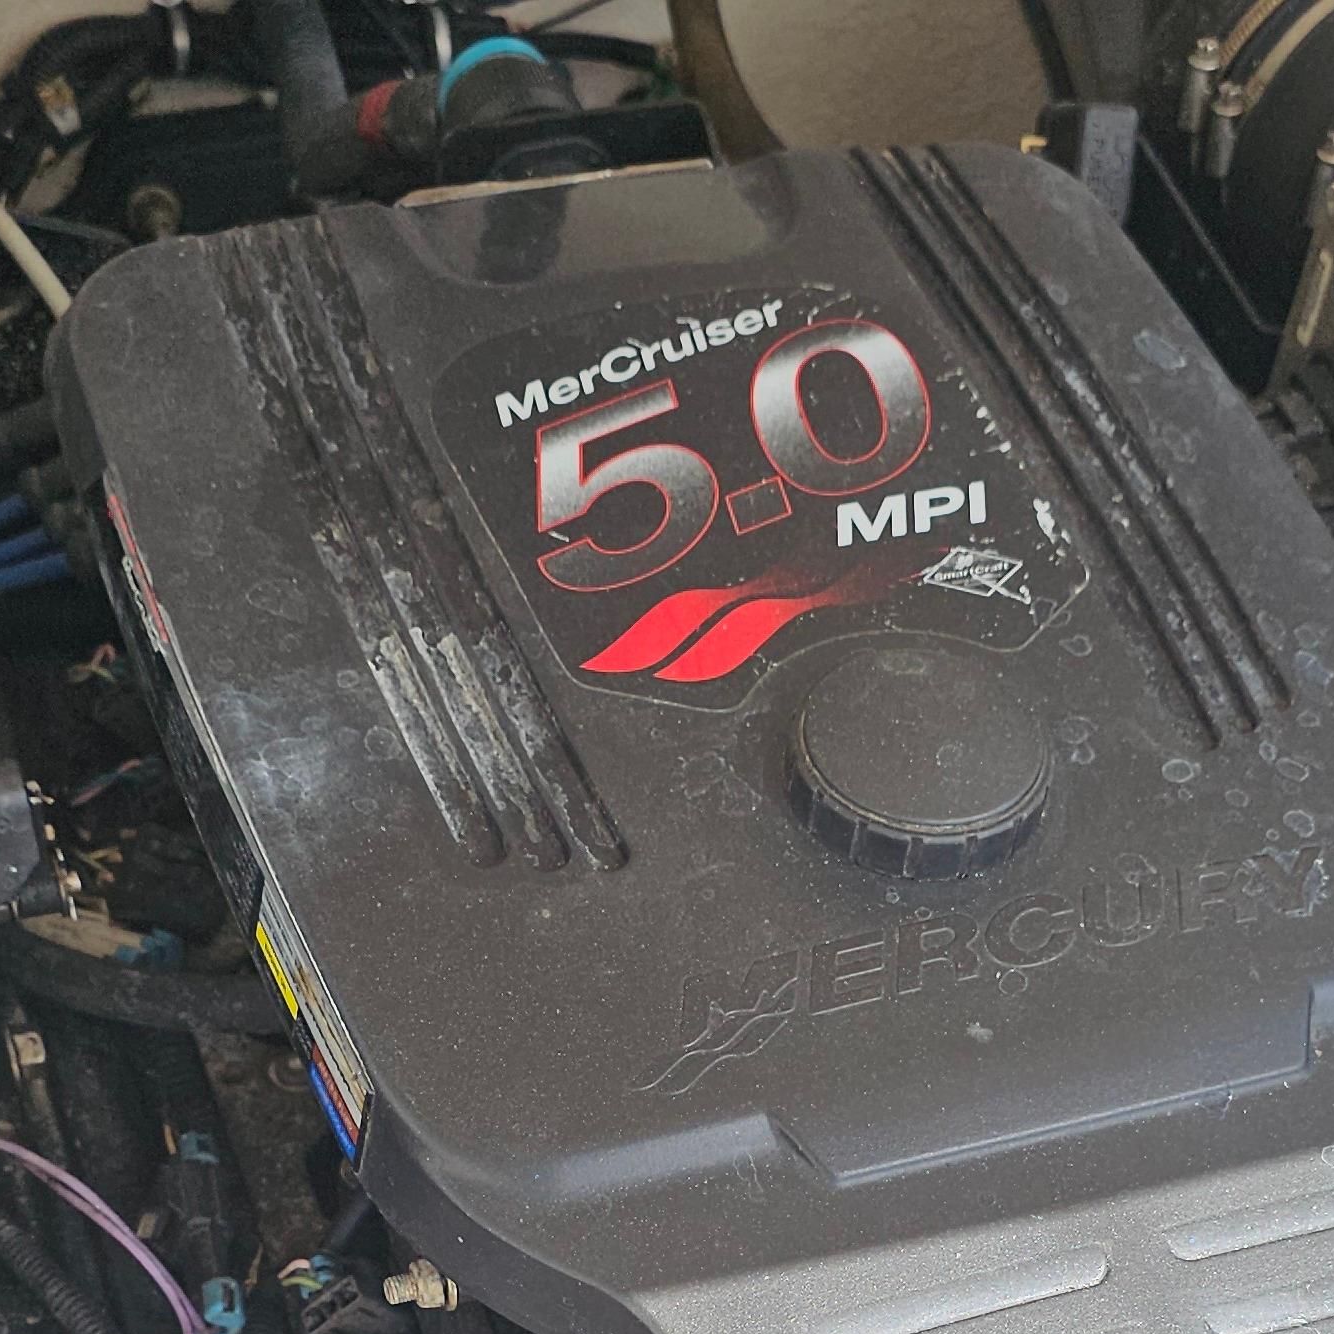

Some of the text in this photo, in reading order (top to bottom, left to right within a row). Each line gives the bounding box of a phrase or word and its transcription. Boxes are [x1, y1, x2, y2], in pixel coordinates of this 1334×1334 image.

[494, 298, 782, 427] MerCruiser
[534, 318, 932, 592] 5.0
[836, 480, 987, 547] MPI
[667, 845, 1325, 1060] MERCURY
